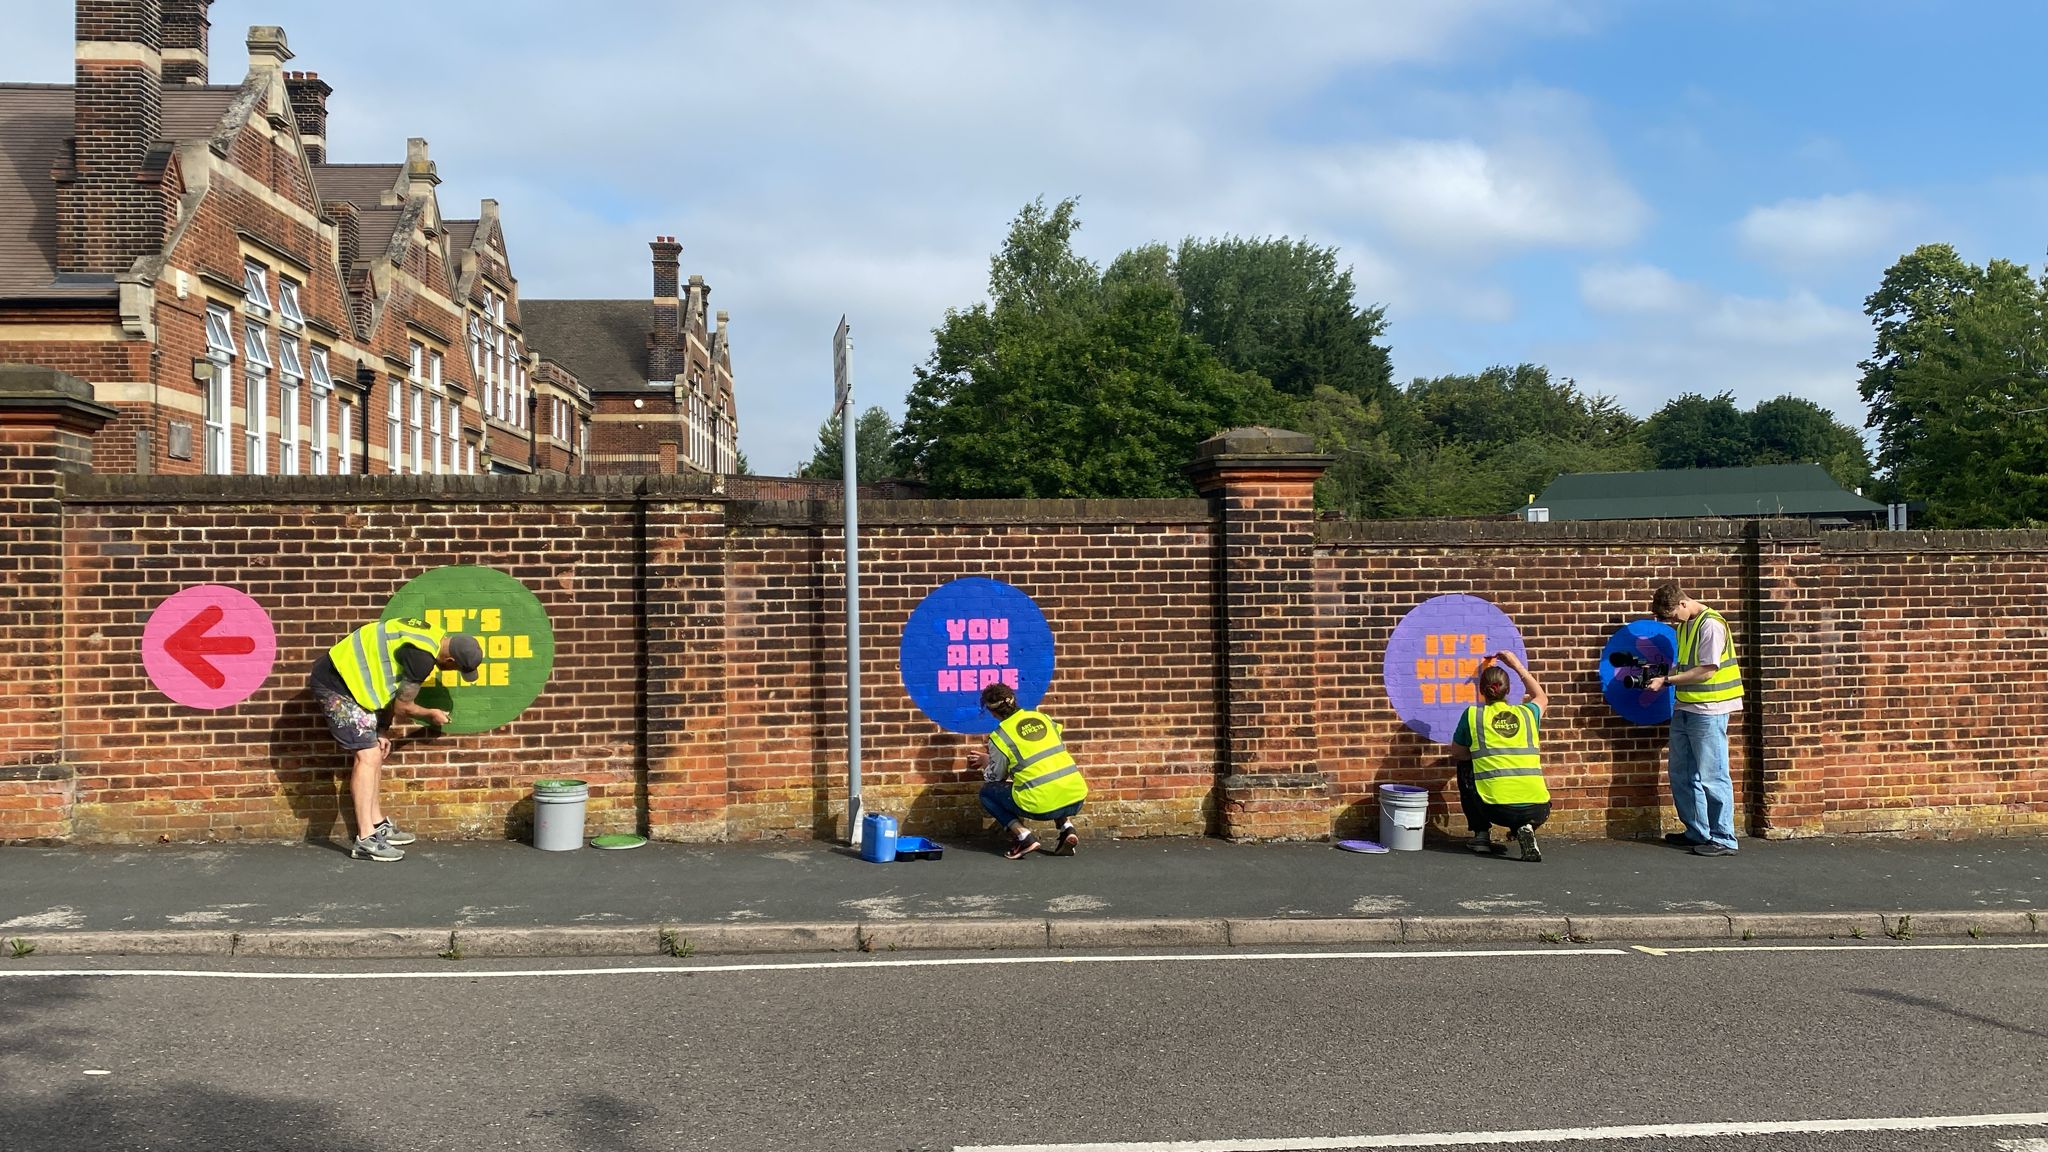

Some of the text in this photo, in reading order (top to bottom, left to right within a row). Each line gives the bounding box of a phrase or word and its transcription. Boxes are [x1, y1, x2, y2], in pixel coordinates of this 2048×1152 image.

[425, 608, 500, 632] IT'S
[946, 618, 1008, 641] YOU
[947, 643, 1008, 666] ARE
[1425, 633, 1486, 655] IT'S
[938, 668, 1018, 692] HERE
[1420, 682, 1485, 704] TIM
